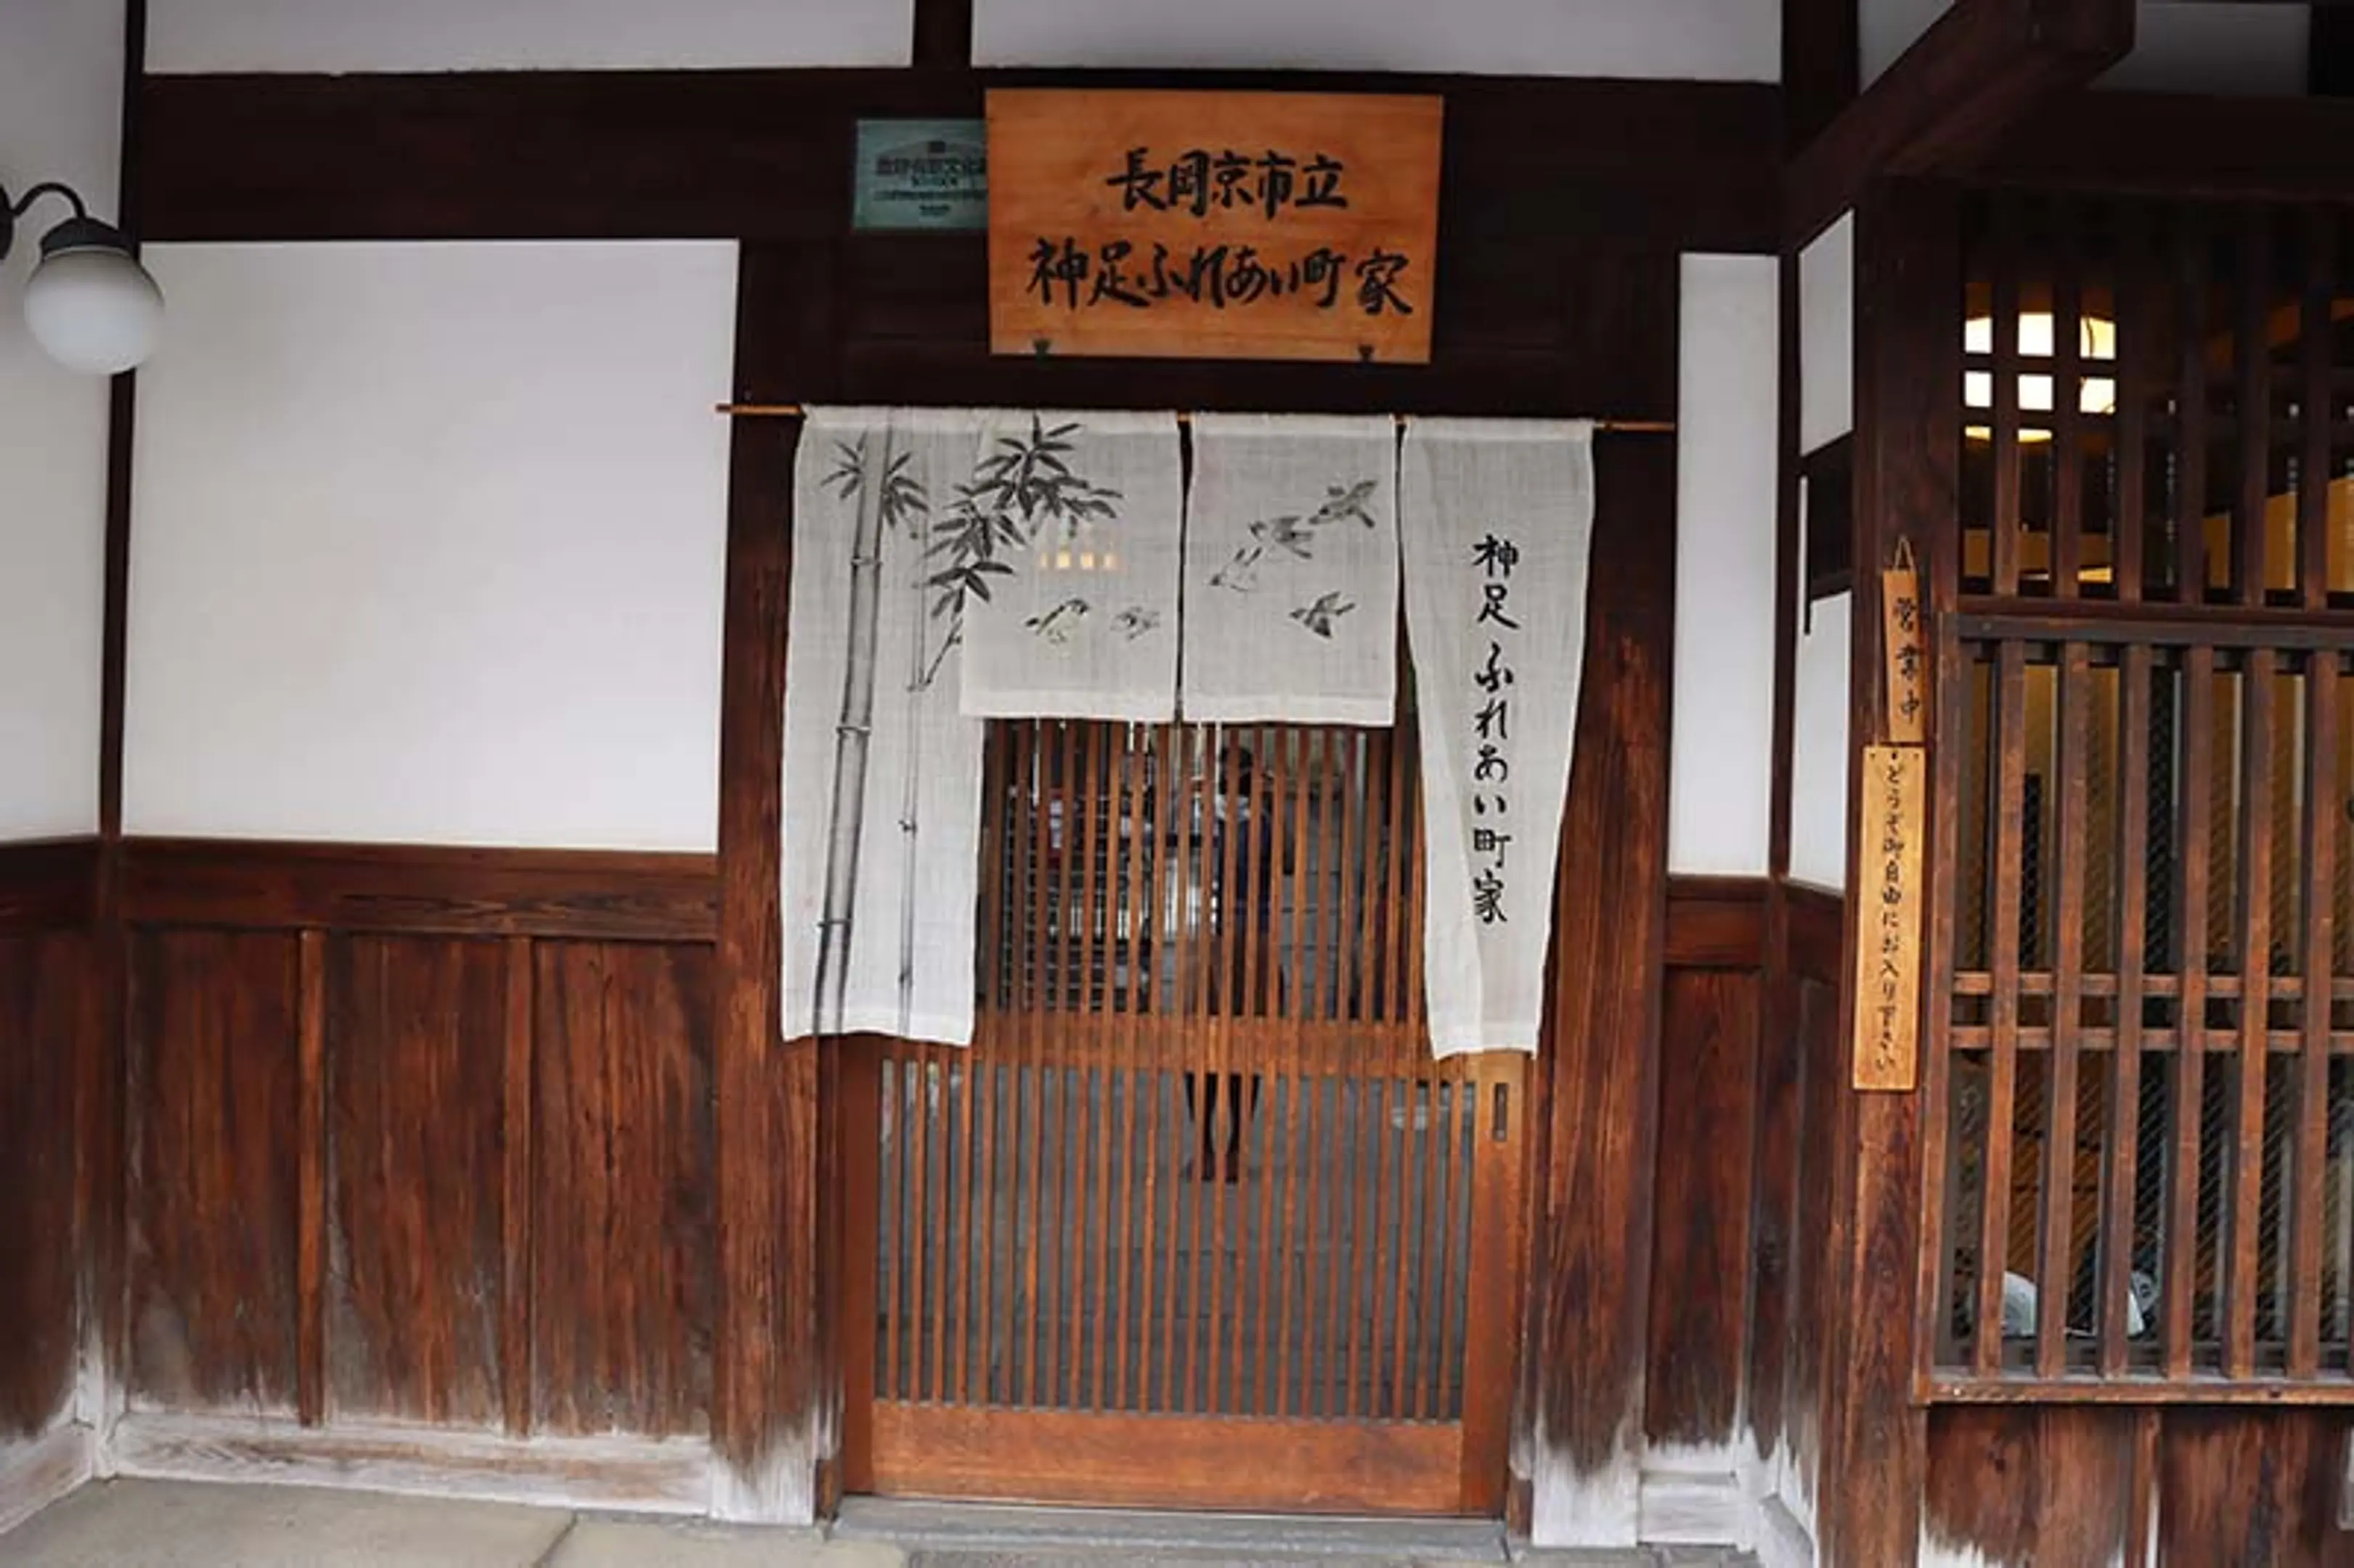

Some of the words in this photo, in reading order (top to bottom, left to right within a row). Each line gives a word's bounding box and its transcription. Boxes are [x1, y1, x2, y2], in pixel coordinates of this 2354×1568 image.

[1106, 148, 1348, 220] 長岡京市立
[1026, 238, 1413, 314] 神足ふれあい町家
[1894, 597, 1920, 724] 営業中
[1473, 534, 1520, 923] 神足ふれあい町家
